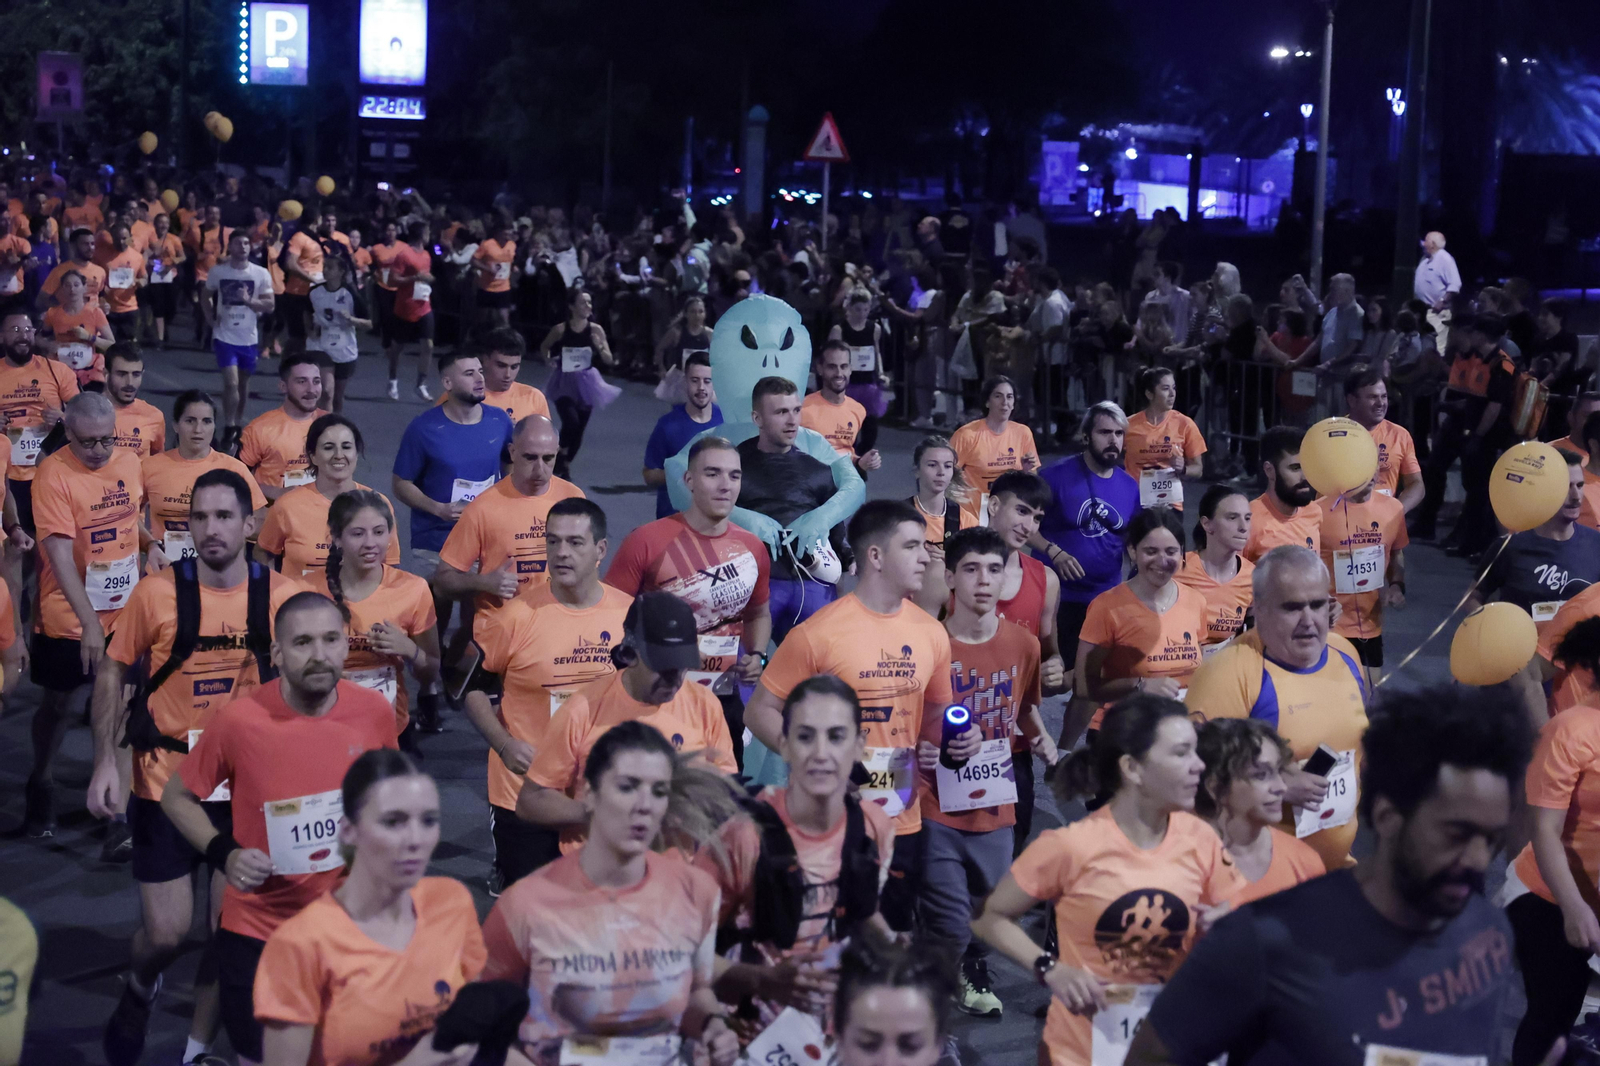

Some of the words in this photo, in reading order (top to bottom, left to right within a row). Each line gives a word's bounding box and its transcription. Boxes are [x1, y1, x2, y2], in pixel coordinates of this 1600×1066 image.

[265, 10, 298, 56] P
[362, 96, 421, 115] 22:04
[20, 439, 41, 450] 5195
[1151, 480, 1172, 490] 9250
[101, 491, 130, 503] NOCTURNA
[90, 501, 115, 511] SEVILLA
[115, 498, 130, 507] KH7
[1340, 538, 1367, 546] SEVILLA
[1346, 561, 1377, 576] 21531
[697, 563, 739, 587] XIII
[104, 573, 130, 590] 2994
[1207, 624, 1230, 632] VILLA
[554, 655, 590, 665] SEVILLA
[593, 654, 613, 664] KH7
[1147, 654, 1181, 662] SEVILLA
[877, 661, 916, 669] NOCTURNA
[859, 670, 894, 679] SEVILLA
[894, 669, 915, 678] KH7
[953, 762, 1000, 783] 14695
[291, 818, 341, 843] 1109
